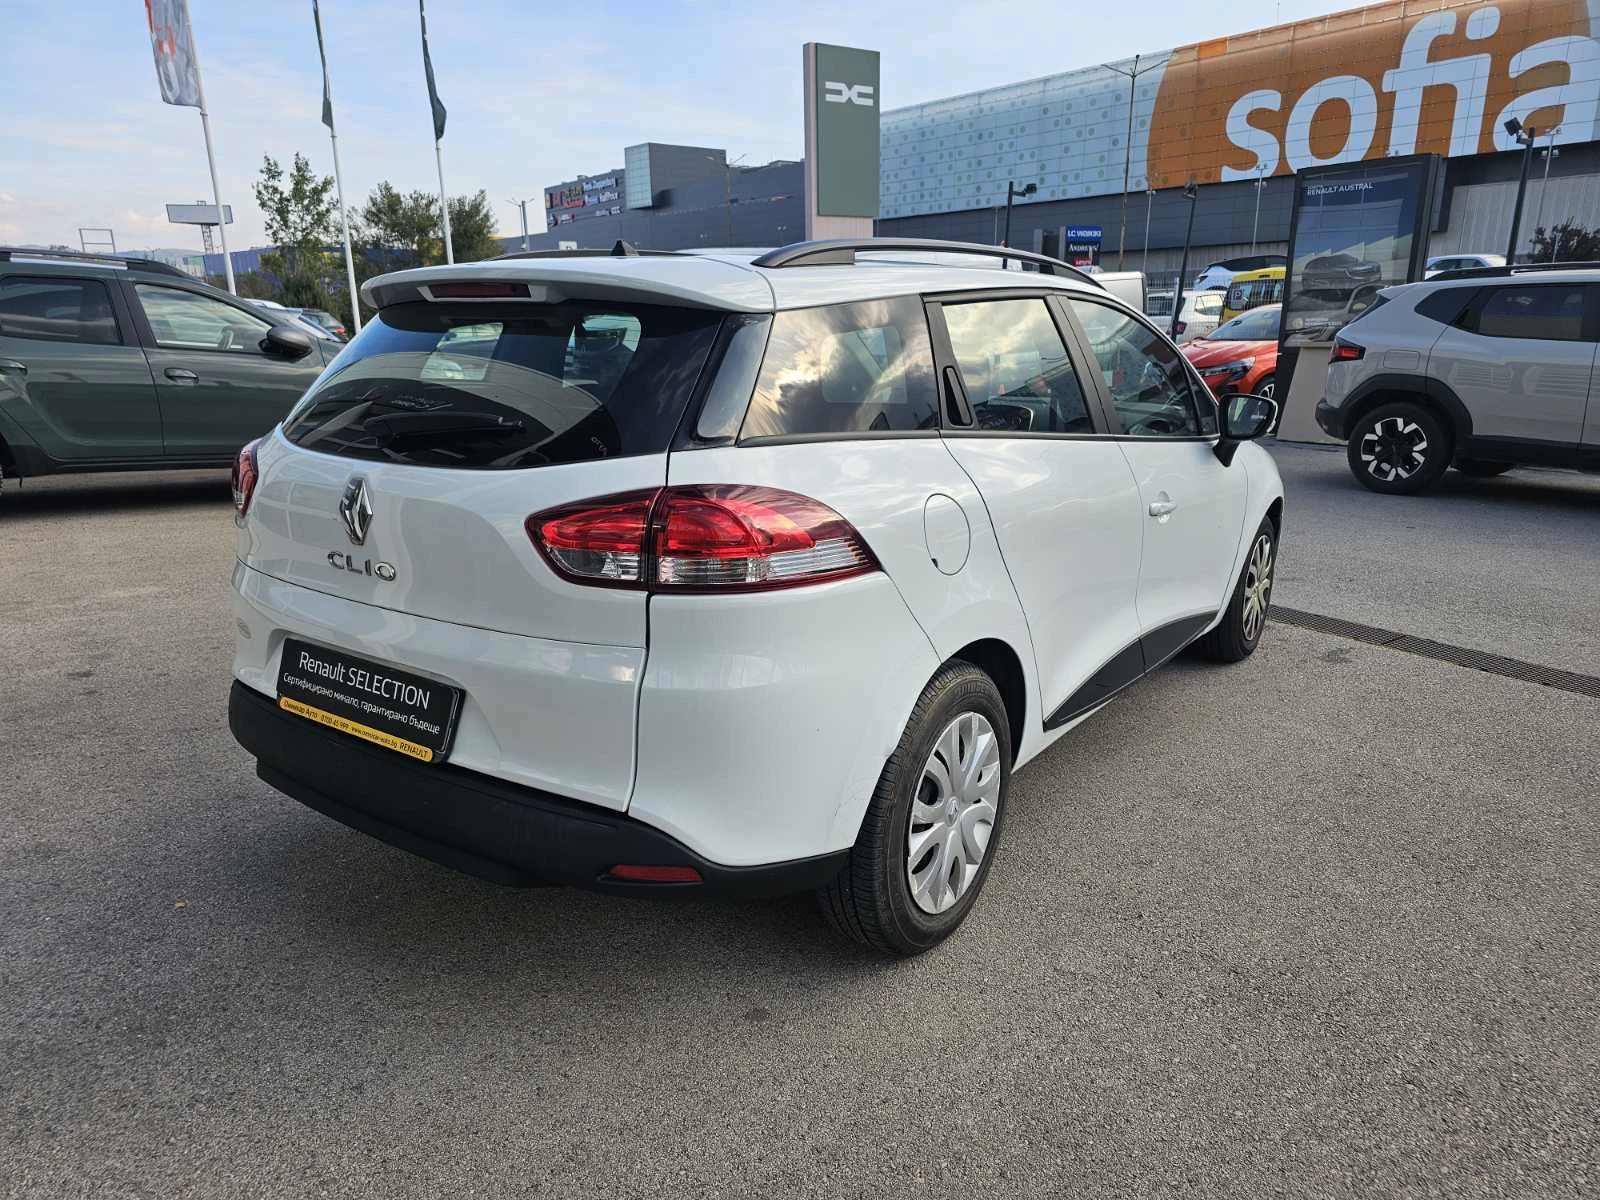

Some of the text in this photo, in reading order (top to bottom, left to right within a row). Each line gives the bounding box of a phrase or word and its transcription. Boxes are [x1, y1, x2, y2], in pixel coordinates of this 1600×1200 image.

[1221, 7, 1600, 182] sofia
[1307, 186, 1337, 196] RENAULT
[1339, 182, 1374, 192] AUSTRAL
[327, 550, 397, 582] CLIO
[283, 672, 441, 735] Сертифицирано минало, гарантирано бъдеще
[299, 651, 430, 711] Renault SELECTION
[400, 742, 428, 758] RENAULT
